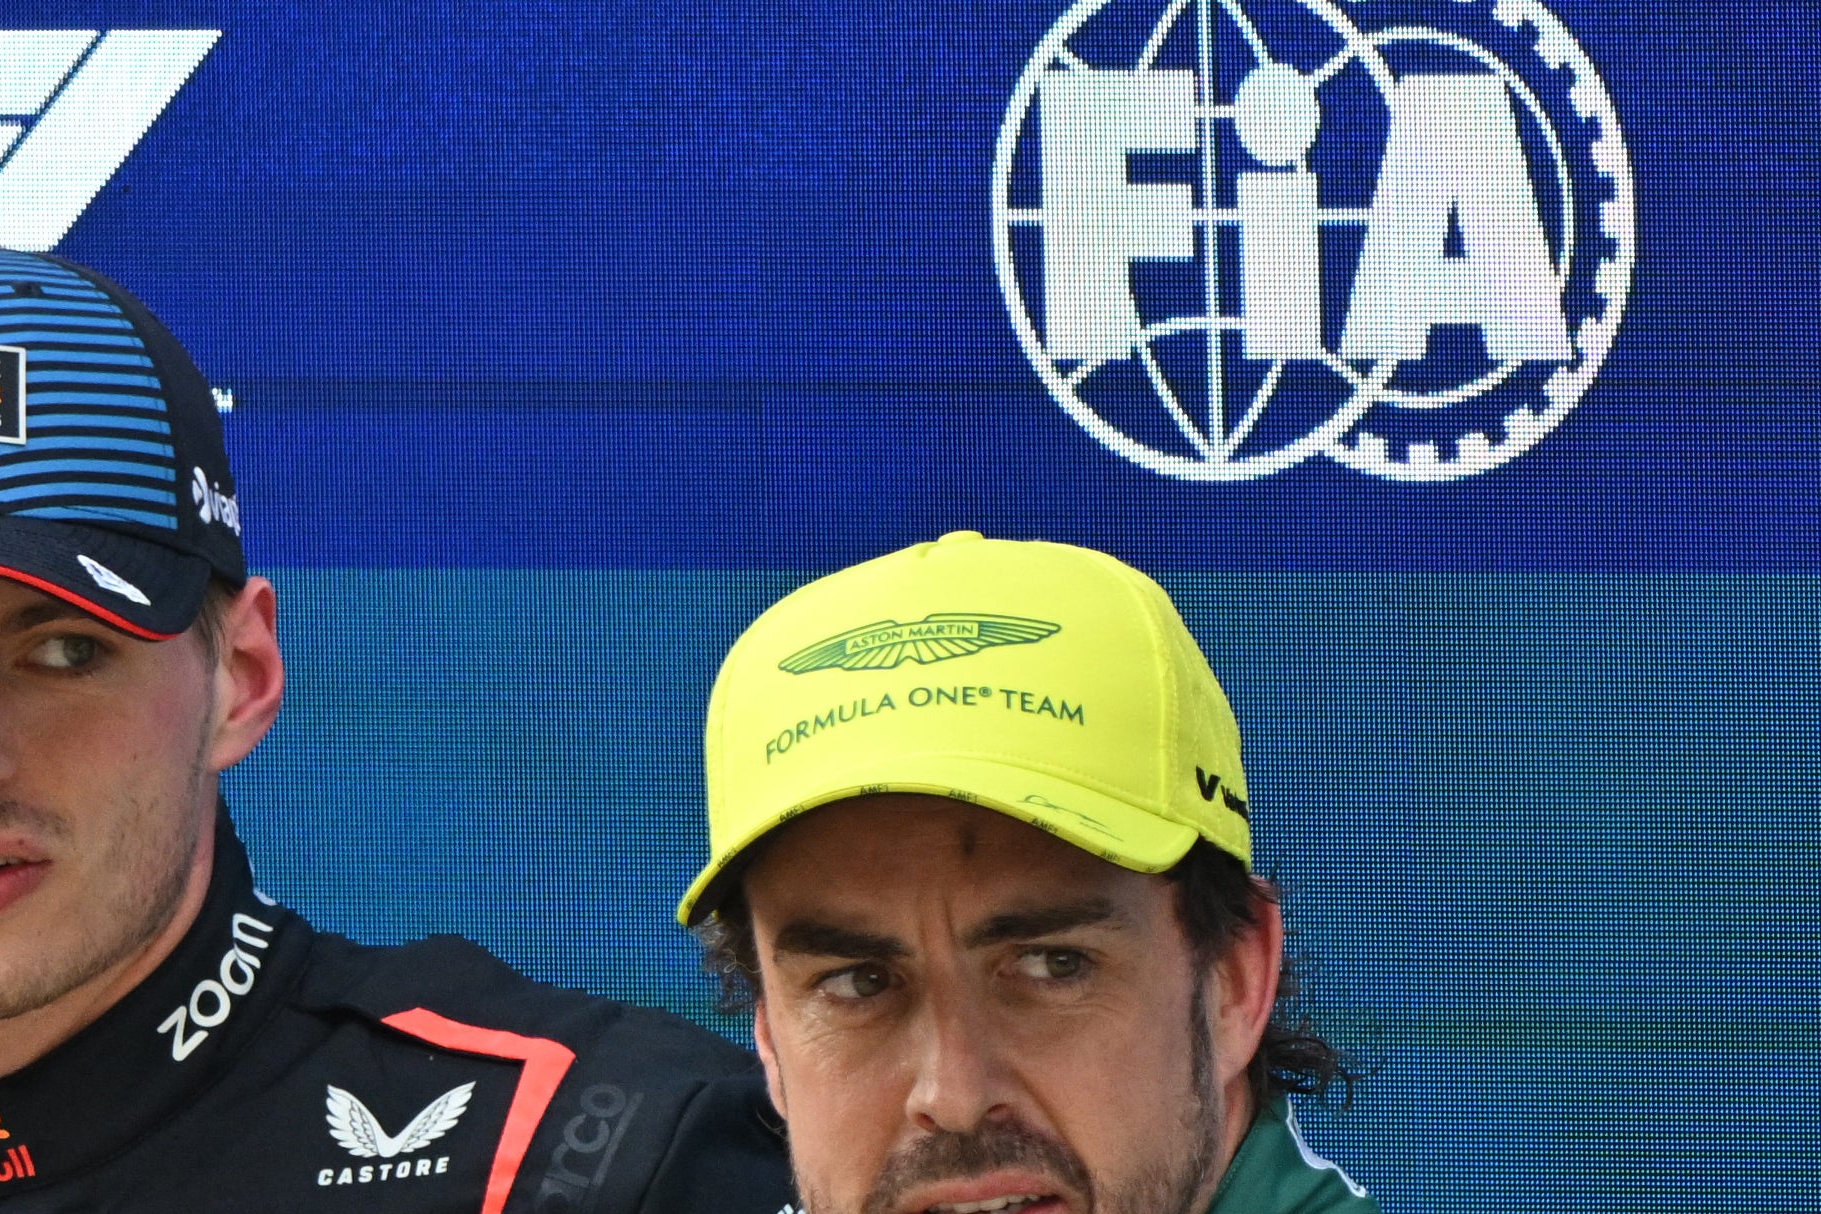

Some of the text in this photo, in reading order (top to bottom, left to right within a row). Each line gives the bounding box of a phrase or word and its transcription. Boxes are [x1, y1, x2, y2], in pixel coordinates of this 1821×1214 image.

[849, 623, 974, 652] ASTON MARTIN
[765, 693, 897, 765] FORMULA
[1000, 688, 1085, 726] TEAM
[318, 1156, 451, 1187] CASTORE
